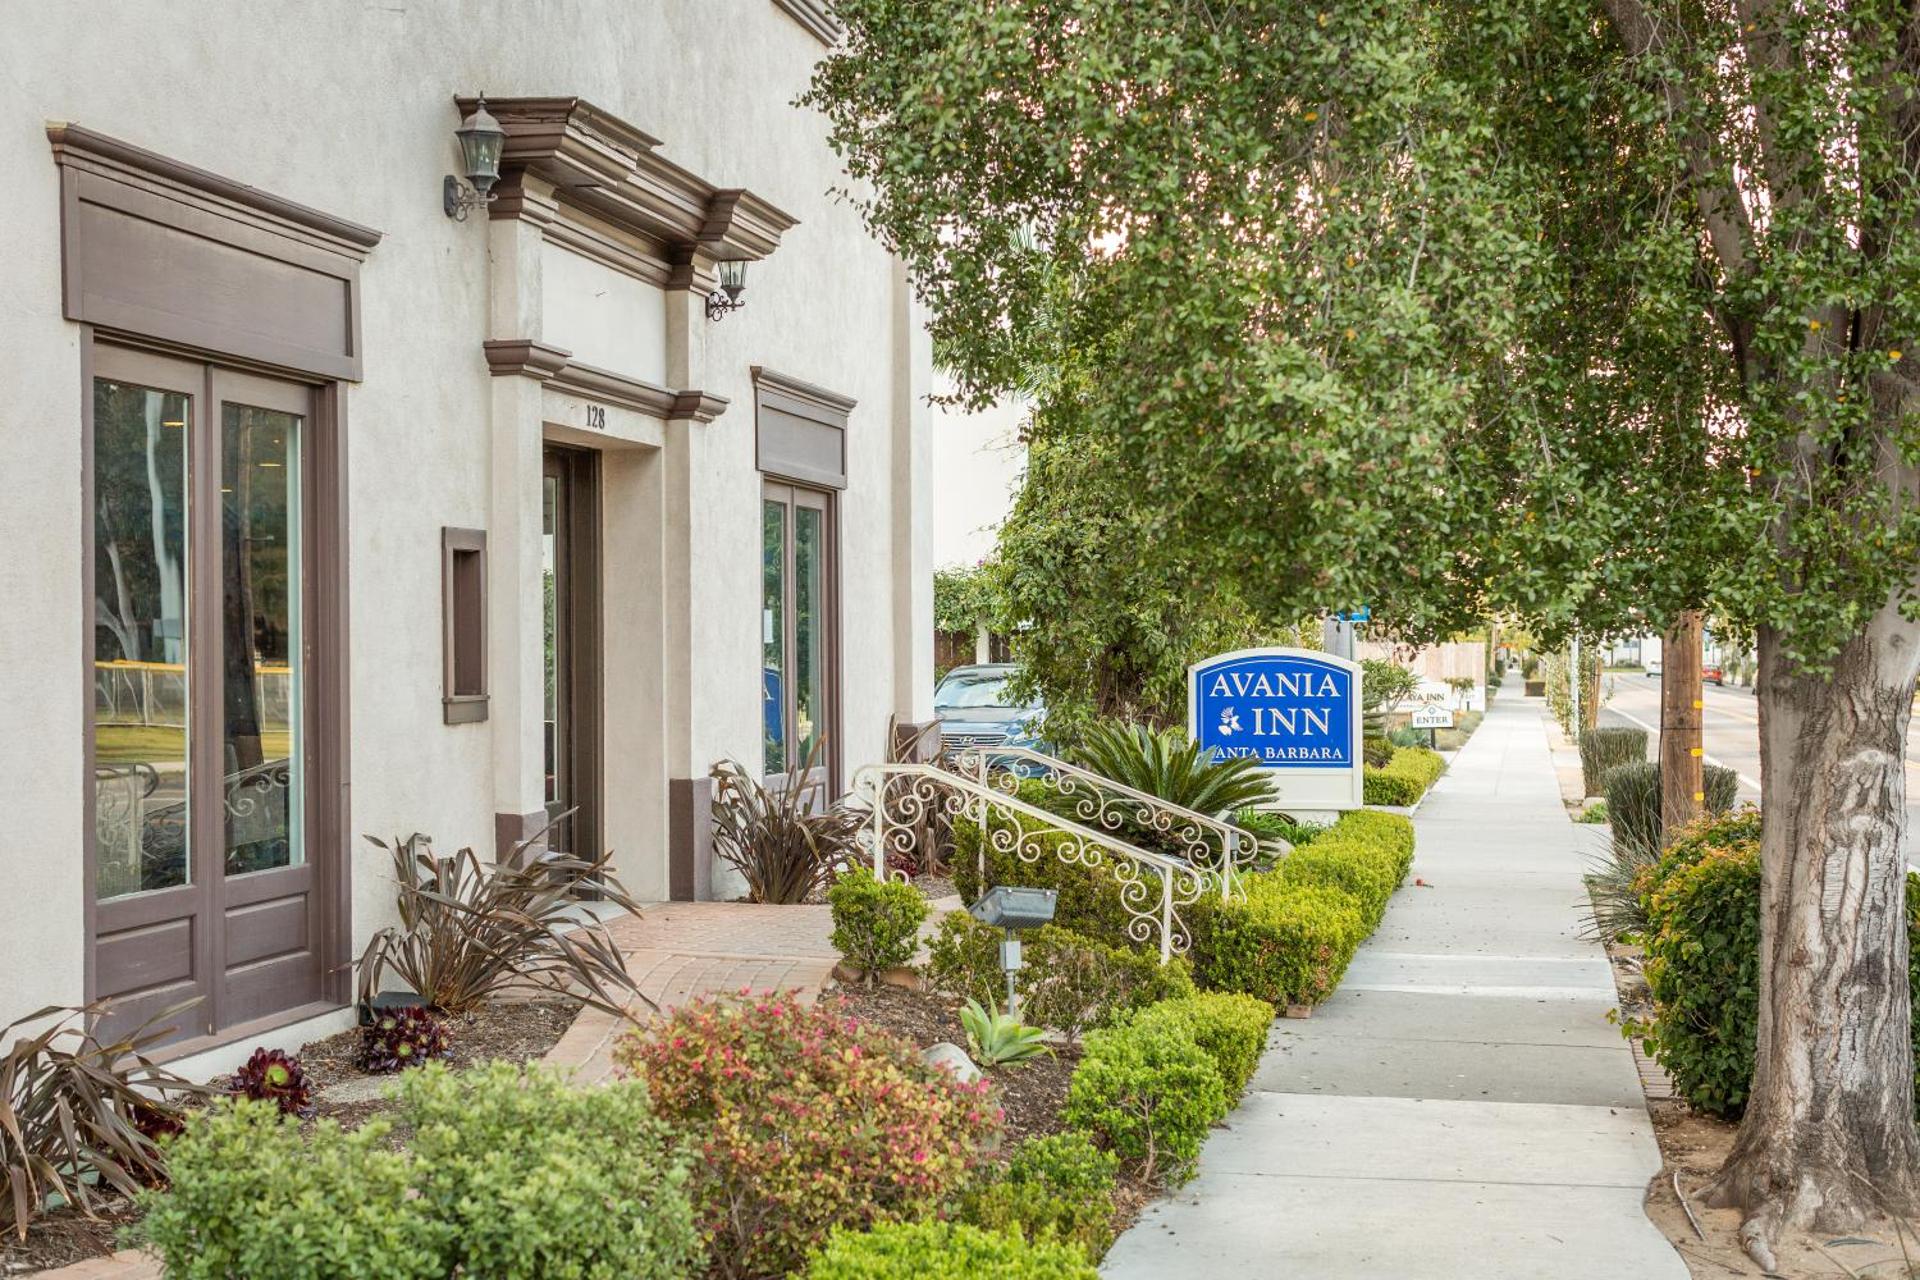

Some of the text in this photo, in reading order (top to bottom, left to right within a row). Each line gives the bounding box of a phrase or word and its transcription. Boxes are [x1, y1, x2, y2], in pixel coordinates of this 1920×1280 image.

[587, 405, 605, 430] 128
[1209, 672, 1341, 698] AVANIA
[1402, 693, 1445, 702] AYA INN
[1252, 707, 1332, 736] INN
[1211, 746, 1342, 759] ANTA BARBARA
